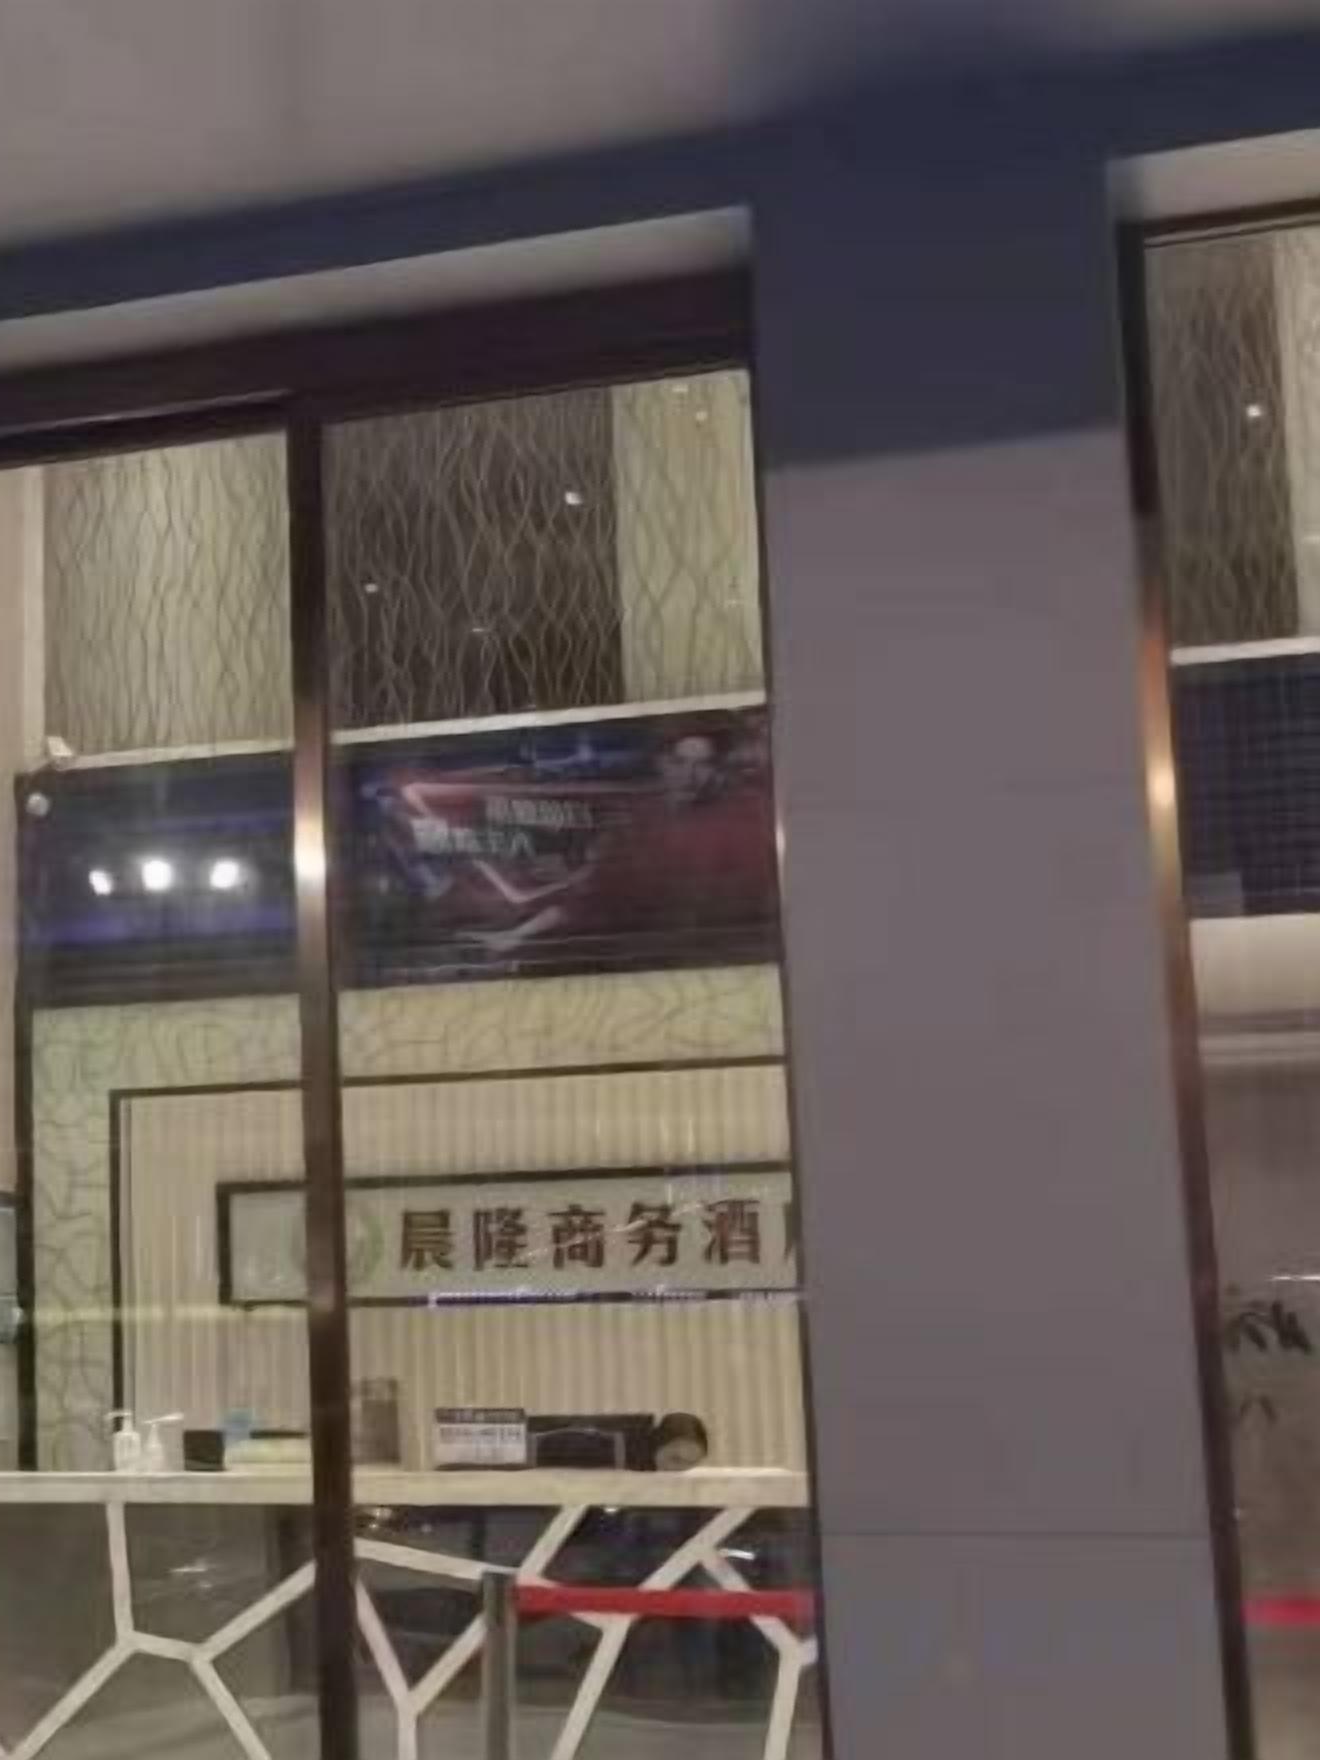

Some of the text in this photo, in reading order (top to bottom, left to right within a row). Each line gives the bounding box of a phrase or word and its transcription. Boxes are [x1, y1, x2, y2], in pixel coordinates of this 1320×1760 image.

[400, 1200, 794, 1271] 晨隆商务酒
